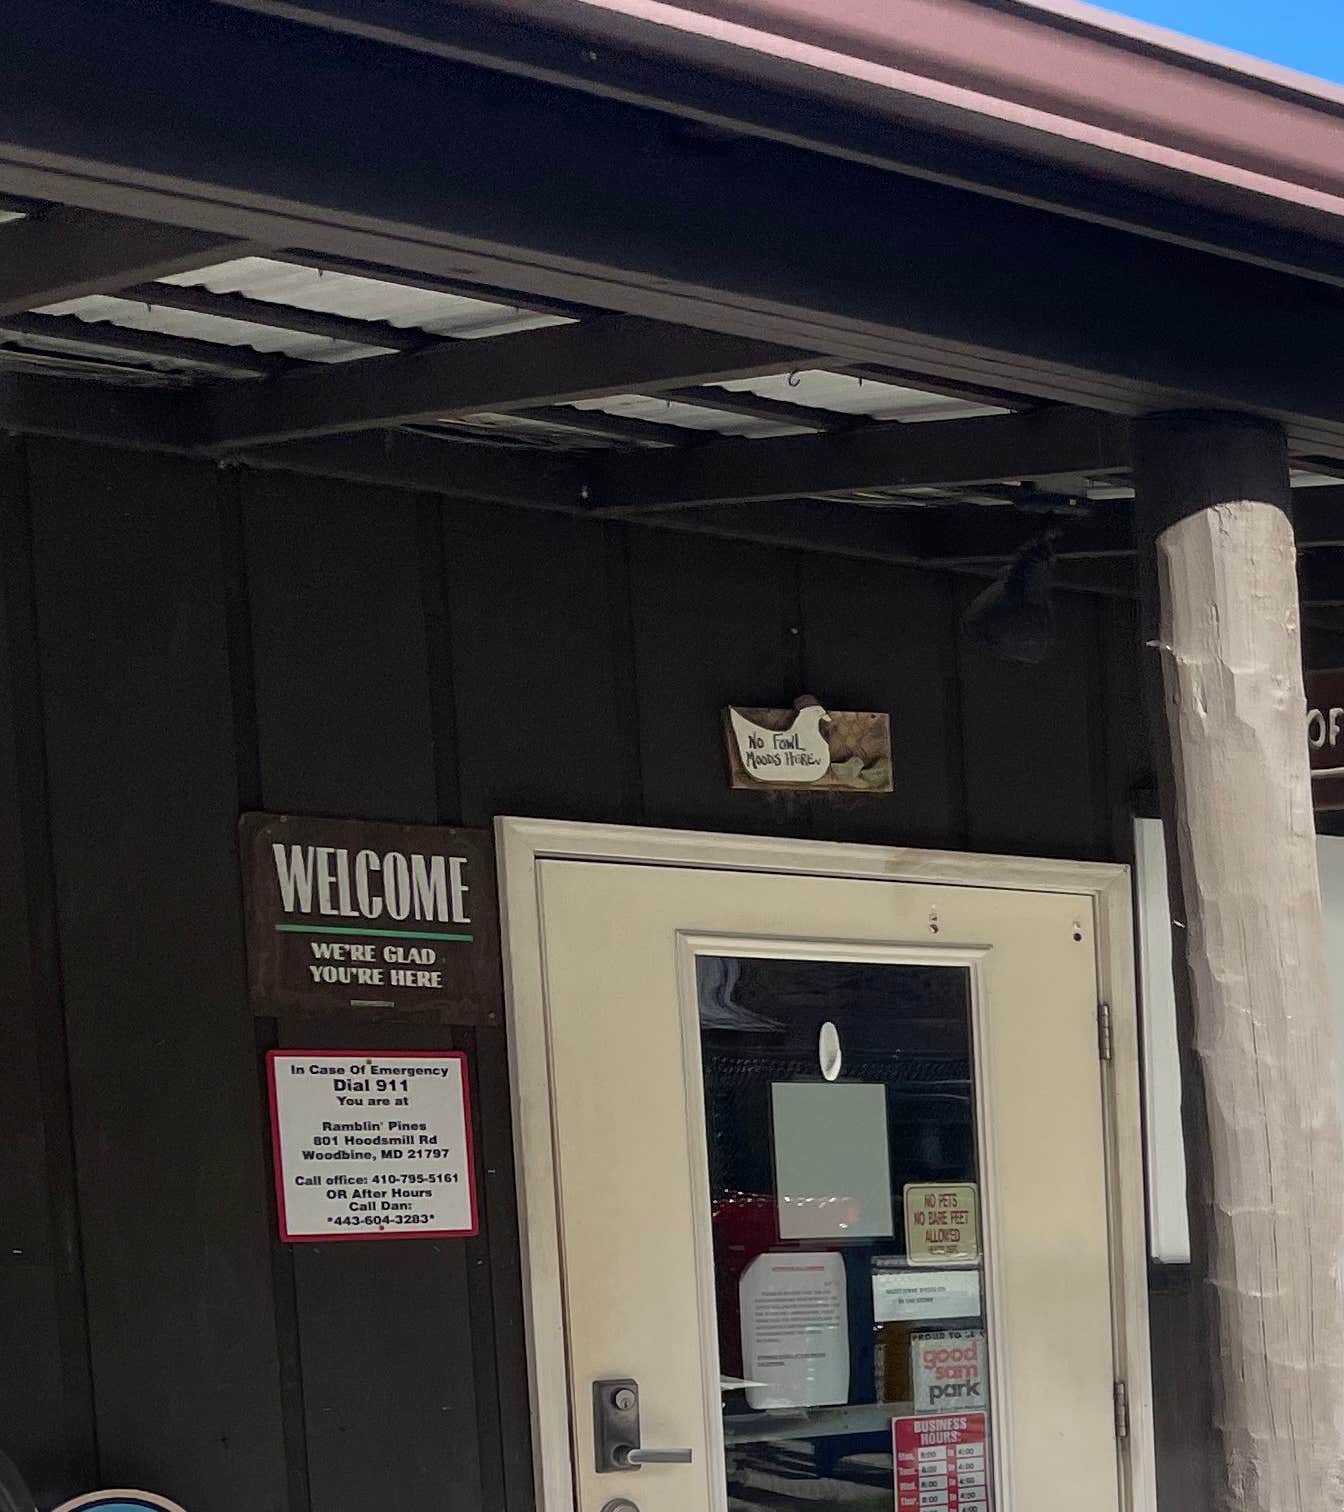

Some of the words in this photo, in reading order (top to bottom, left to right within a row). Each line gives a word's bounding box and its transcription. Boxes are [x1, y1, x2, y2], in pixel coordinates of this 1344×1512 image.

[272, 843, 472, 923] WELCOME
[310, 942, 376, 963] WE'RE
[383, 945, 436, 965] GLAD
[309, 965, 385, 986] YOU'RE
[390, 969, 444, 989] HERE
[291, 1065, 304, 1075] In
[309, 1065, 345, 1075] Case
[350, 1065, 365, 1075] Of
[371, 1065, 449, 1078] Emergency
[334, 1079, 370, 1091] Dial
[376, 1079, 409, 1091] 911
[337, 1096, 363, 1106] You
[368, 1098, 390, 1106] are
[395, 1097, 409, 1106] at
[322, 1122, 383, 1131] Ramblin'
[388, 1121, 427, 1131] Pines
[313, 1136, 338, 1146] 801
[345, 1135, 415, 1145] Hoodsmill
[419, 1135, 437, 1145] Rd
[302, 1149, 377, 1161] Woodbine,
[381, 1149, 403, 1159] MD
[407, 1149, 449, 1159] 21797
[295, 1176, 322, 1186] Call
[326, 1175, 368, 1185] office:
[372, 1173, 459, 1185] 410-795-5161
[326, 1190, 348, 1199] OR
[352, 1189, 387, 1198] After
[392, 1188, 432, 1198] Hours
[349, 1202, 376, 1211] Call
[381, 1201, 413, 1211] Dan:
[923, 1341, 978, 1369] good
[935, 1365, 978, 1380] sam
[929, 1380, 981, 1405] park
[914, 1418, 967, 1433] BUSINESS
